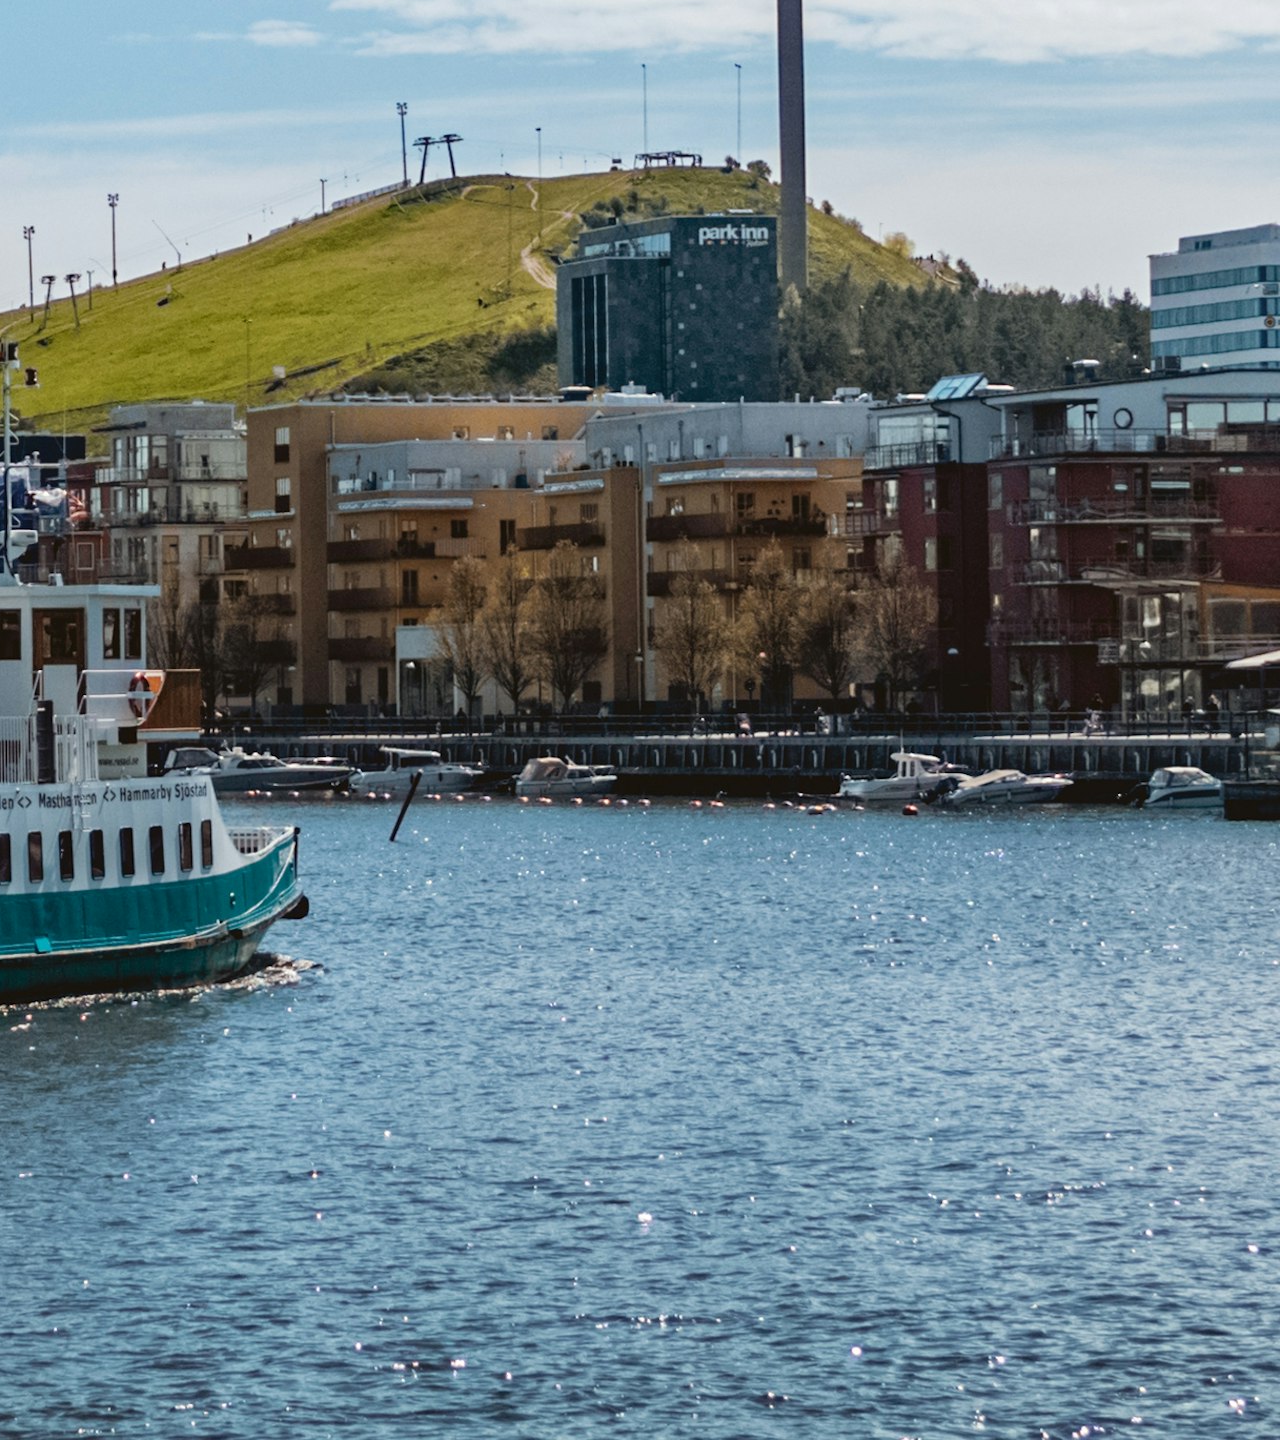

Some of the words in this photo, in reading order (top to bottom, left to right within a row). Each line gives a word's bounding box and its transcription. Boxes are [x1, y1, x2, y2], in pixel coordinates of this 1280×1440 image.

[698, 223, 739, 246] park
[741, 223, 769, 240] inn
[119, 784, 172, 803] Hammarby
[174, 781, 208, 800] Sjöstad
